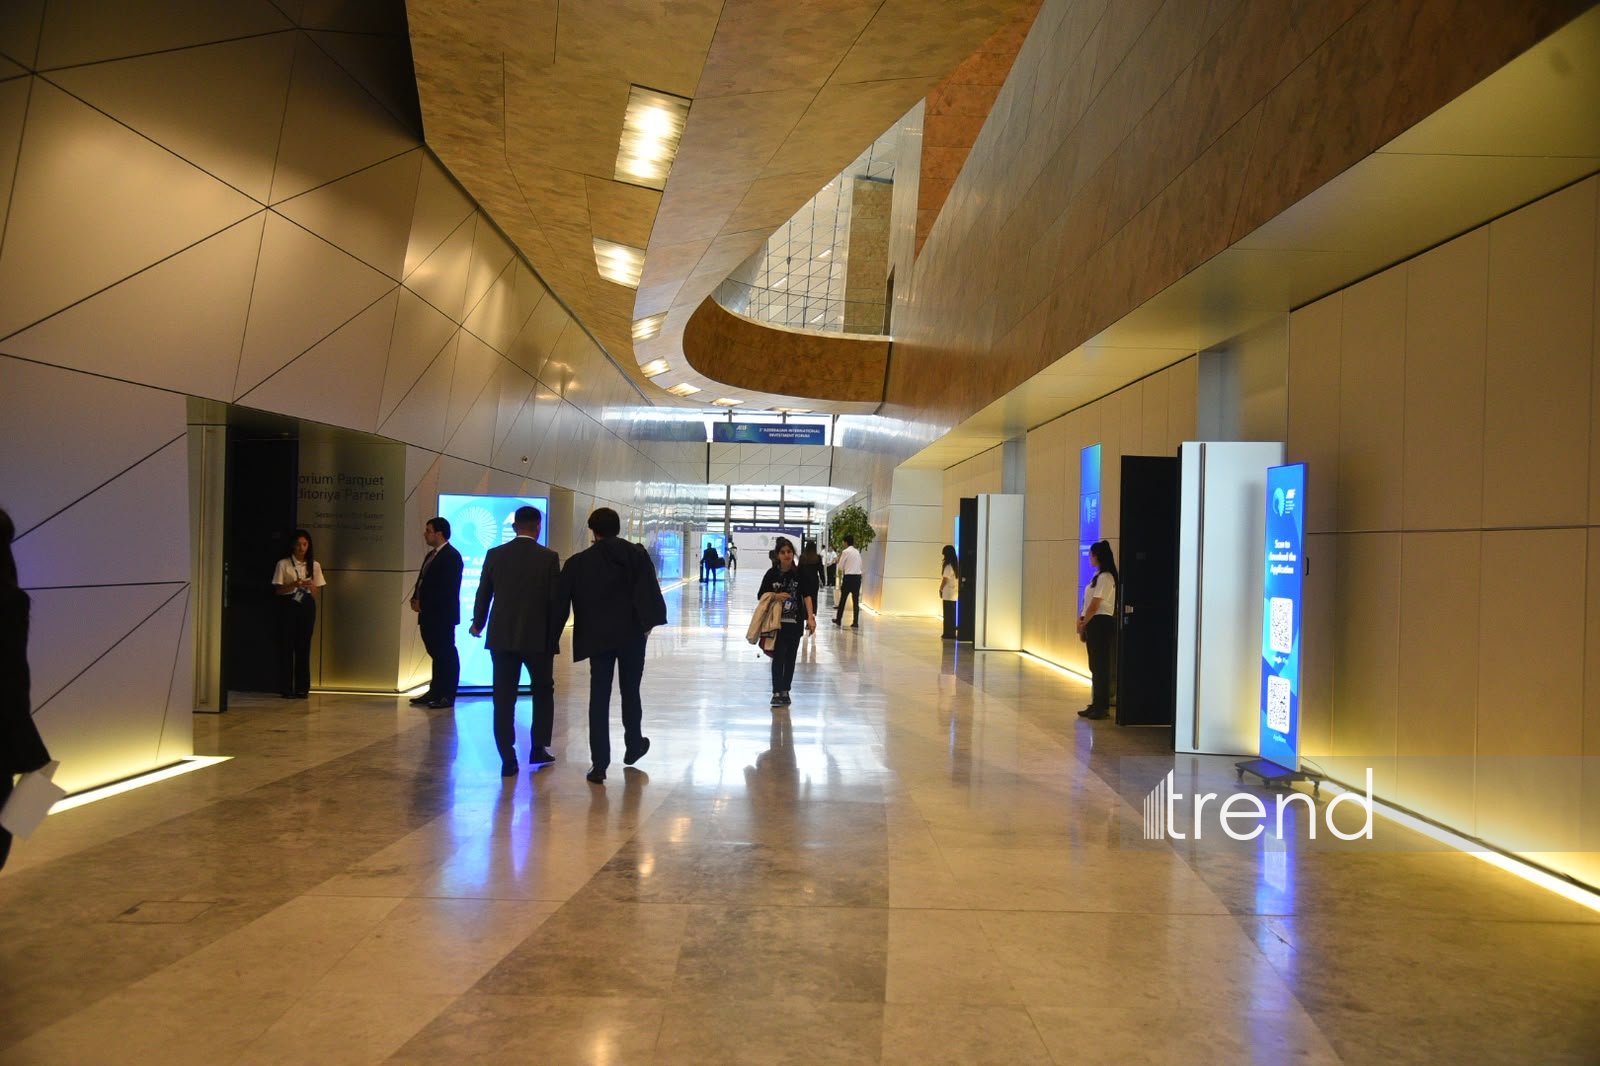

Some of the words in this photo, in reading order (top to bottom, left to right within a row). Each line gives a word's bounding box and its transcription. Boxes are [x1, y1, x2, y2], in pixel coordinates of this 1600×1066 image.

[298, 472, 333, 484] orium
[337, 472, 384, 488] Parquet
[344, 487, 384, 501] Parteri
